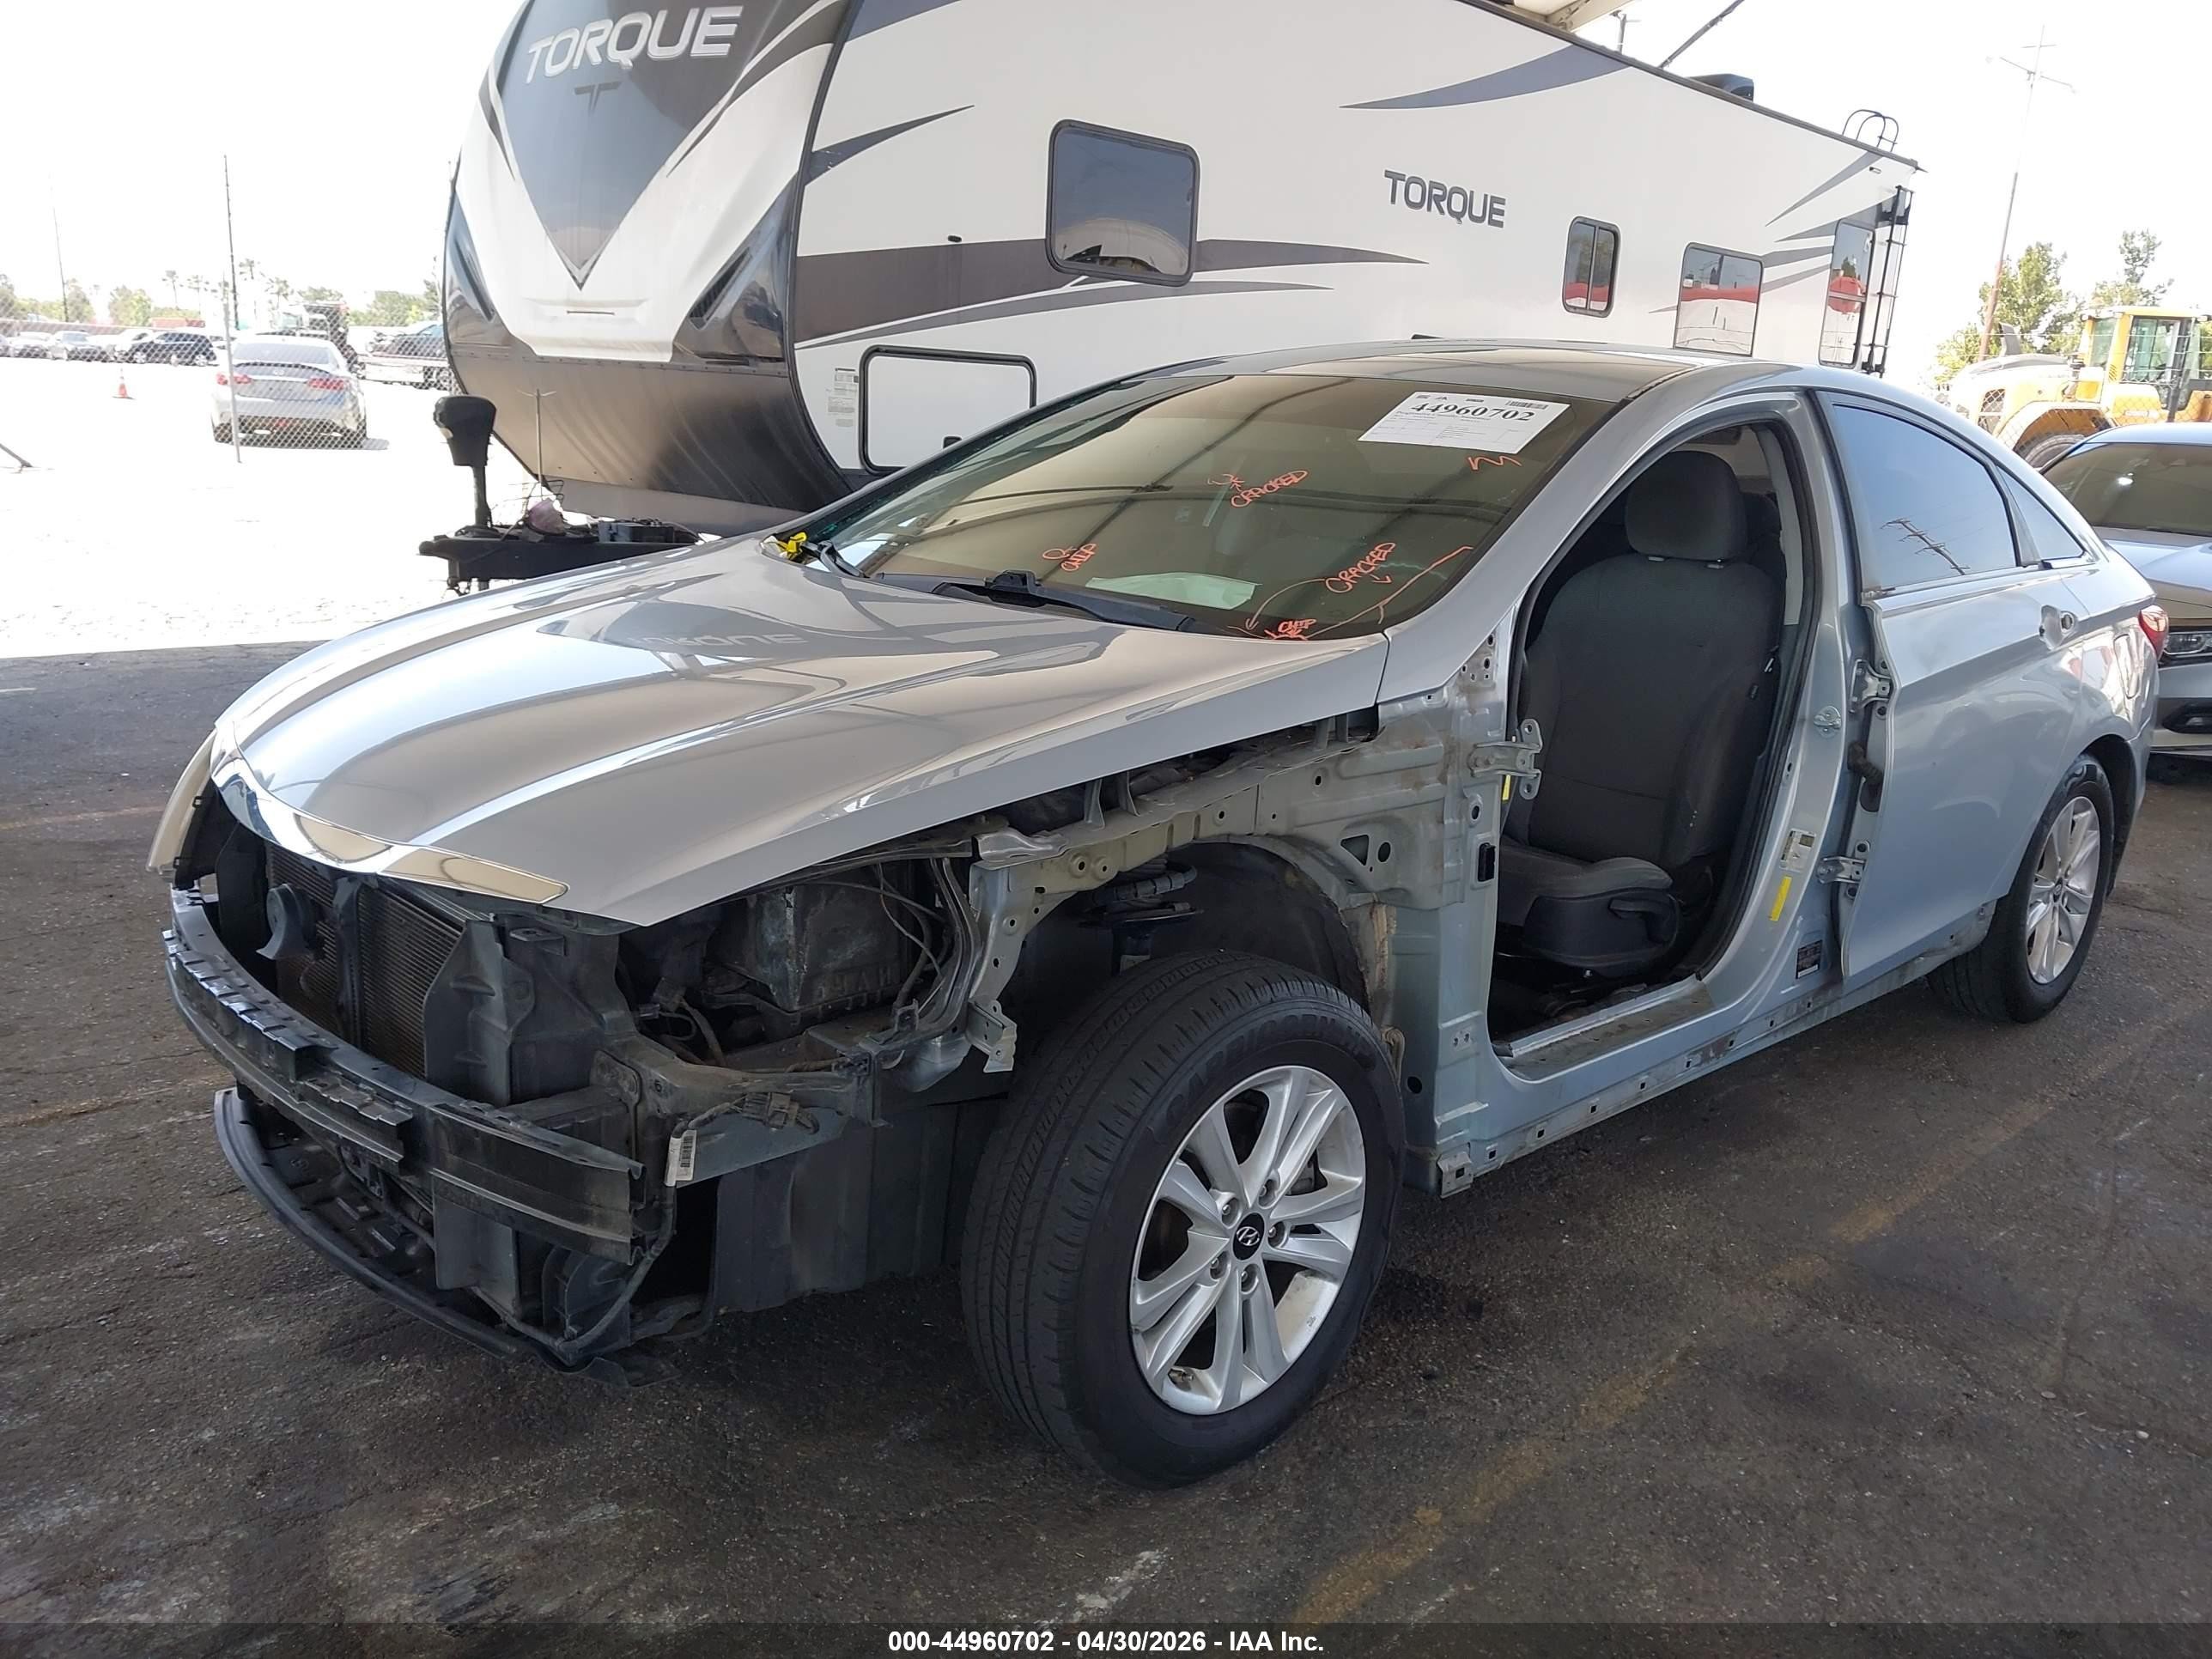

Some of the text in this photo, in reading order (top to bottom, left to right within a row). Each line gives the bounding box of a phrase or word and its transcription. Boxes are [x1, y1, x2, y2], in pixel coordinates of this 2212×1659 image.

[526, 5, 744, 84] TORQUE
[1384, 169, 1506, 228] TORQUE
[1410, 402, 1535, 422] 44960702
[1231, 470, 1308, 507] CRACKED
[1325, 542, 1396, 592] CRACKED
